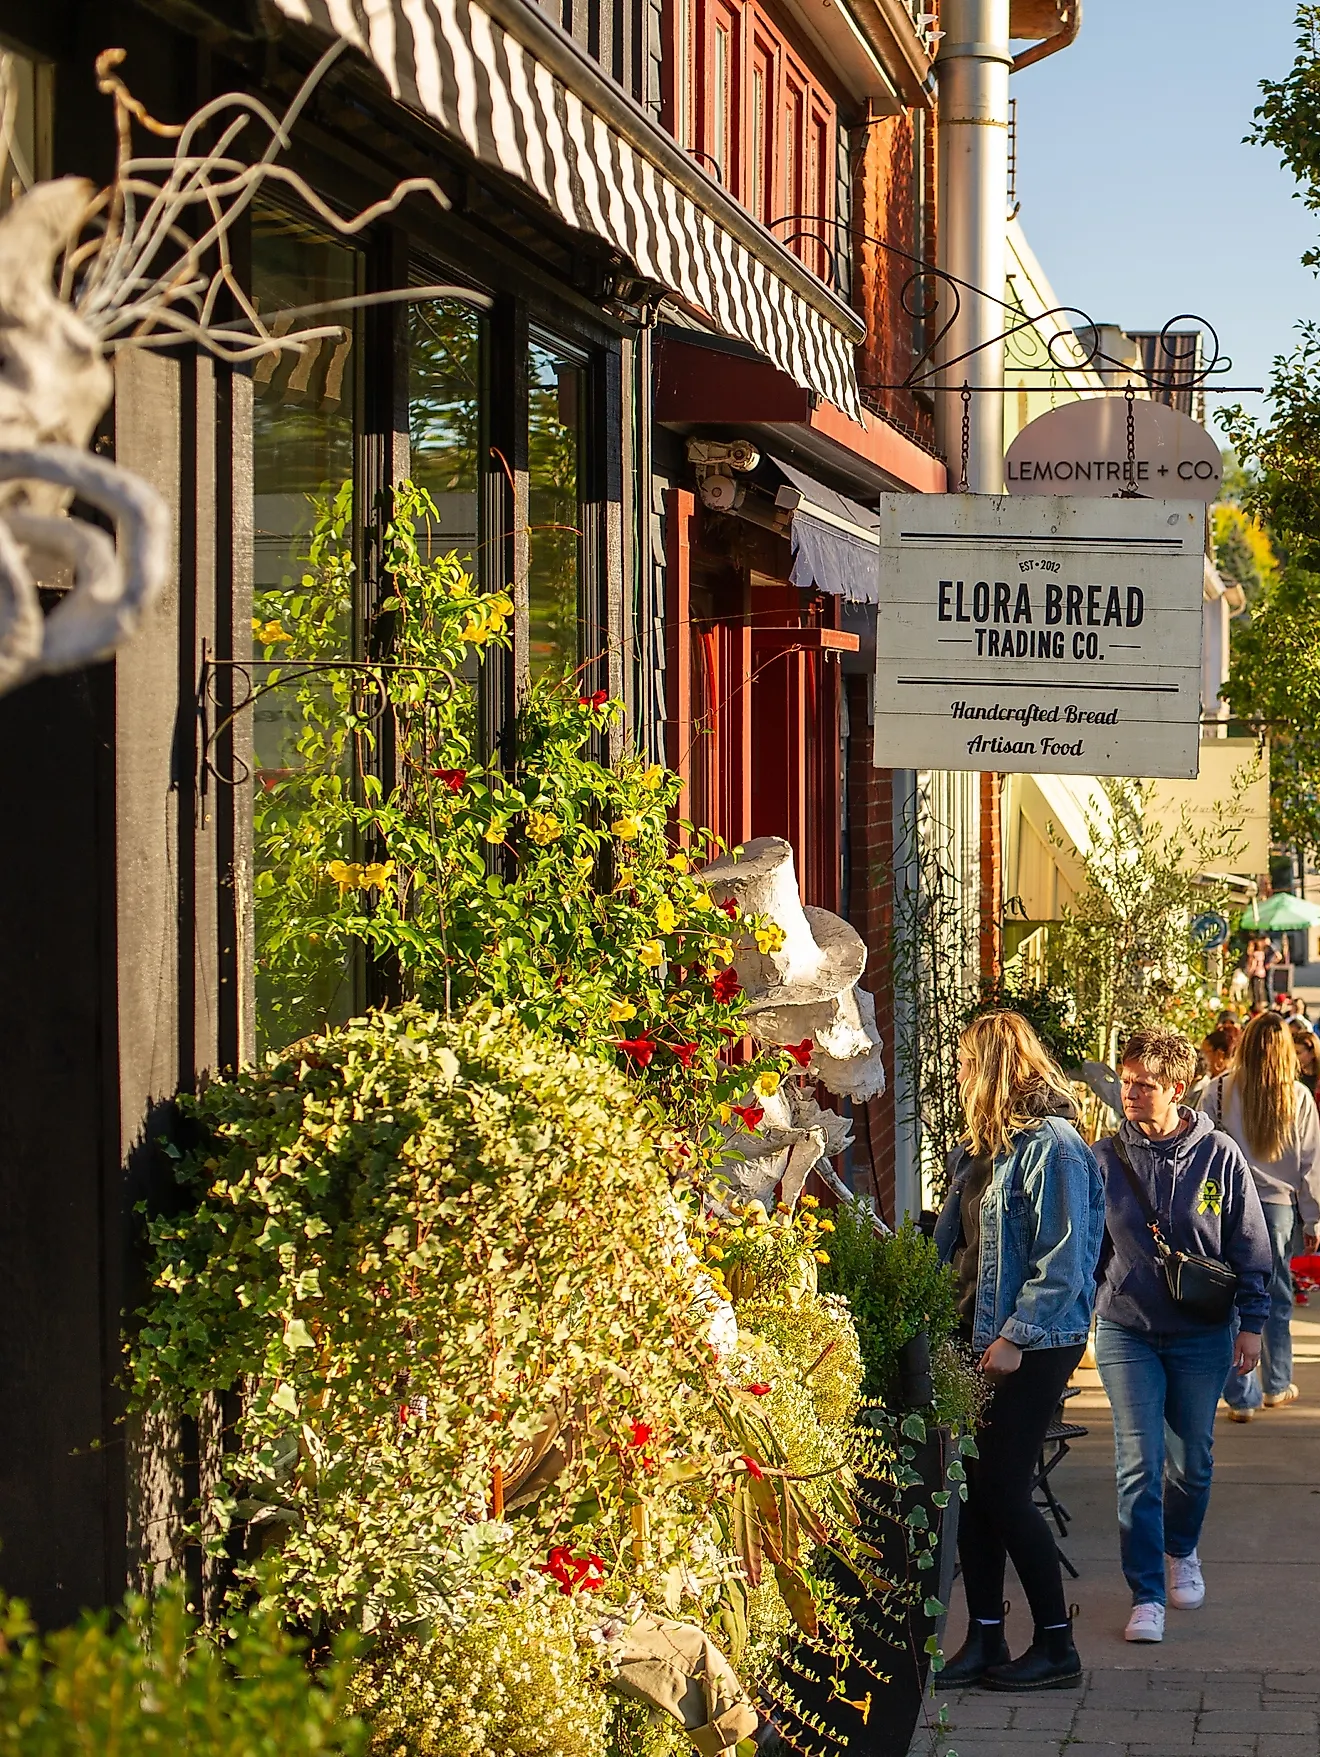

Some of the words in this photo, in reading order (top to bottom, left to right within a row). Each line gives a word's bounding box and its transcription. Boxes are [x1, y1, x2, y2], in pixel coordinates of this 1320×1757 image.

[1007, 460, 1149, 481] LEMONTREE
[1158, 464, 1169, 477] +
[1176, 459, 1220, 482] CO.
[939, 581, 1031, 623] ELORA
[1046, 584, 1143, 627] BREAD
[975, 629, 1064, 659] TRADING
[1072, 632, 1104, 660] CO.
[951, 701, 1060, 727] Handcrafted
[1064, 706, 1119, 726] Bread
[967, 734, 1037, 756] Artisan
[1040, 736, 1085, 757] Food
